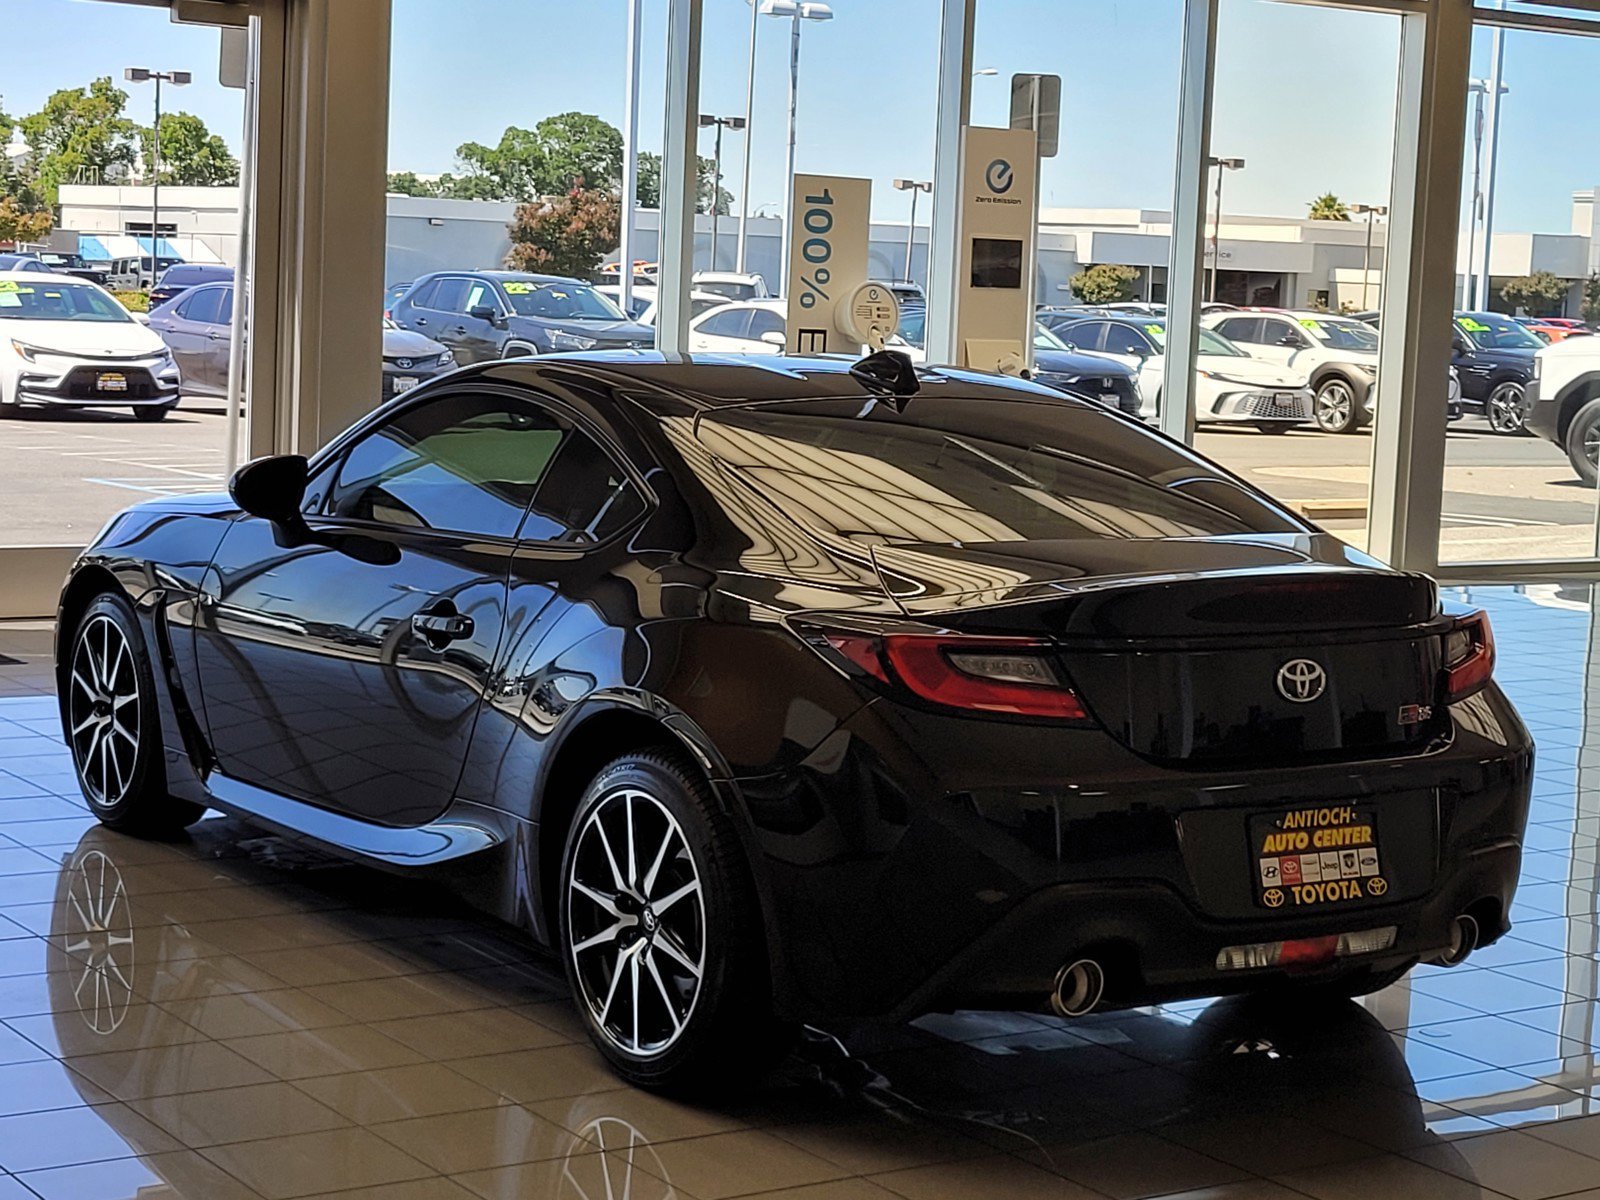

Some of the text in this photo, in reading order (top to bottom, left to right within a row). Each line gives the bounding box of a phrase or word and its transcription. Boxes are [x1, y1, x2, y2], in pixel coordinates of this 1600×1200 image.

[975, 196, 1022, 205] Zero Emission
[800, 188, 834, 309] 100%
[1282, 806, 1351, 830] ANTIOCH
[1262, 825, 1373, 854] AUTO CENTER
[1321, 861, 1339, 871] Jeep
[1291, 880, 1363, 905] TOYOTA
